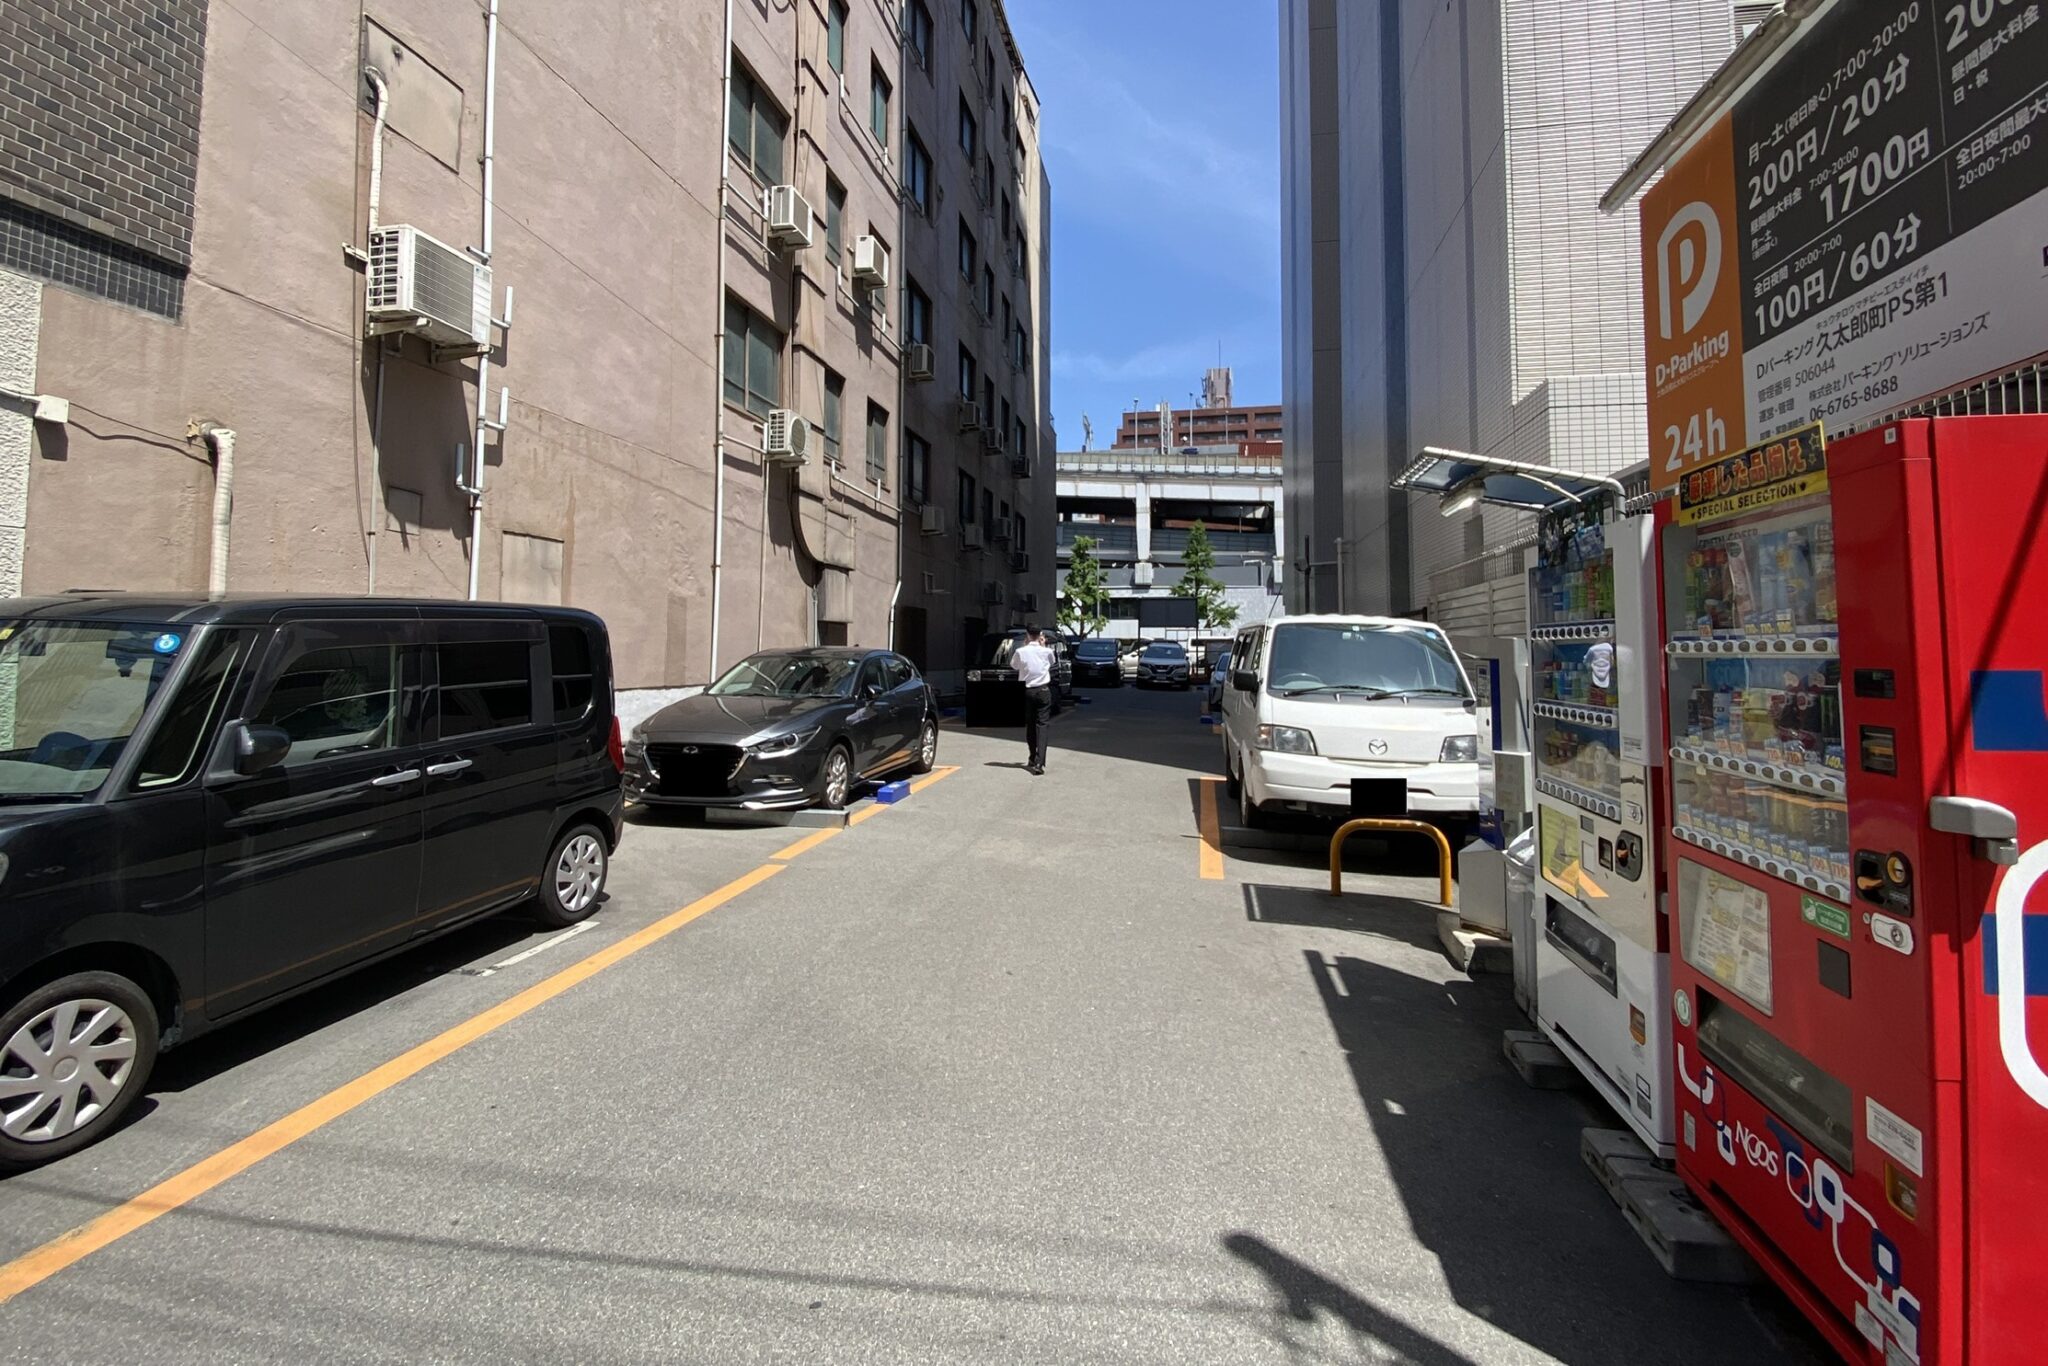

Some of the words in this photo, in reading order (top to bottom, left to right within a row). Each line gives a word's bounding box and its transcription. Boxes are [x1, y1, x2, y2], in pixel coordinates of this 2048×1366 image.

[1833, 2, 1918, 90] 7:00-20:00
[1956, 92, 2048, 170] 全日夜間最大
[1820, 127, 1930, 223] 1700円
[1958, 134, 2031, 190] 20:00-7:00
[1794, 233, 1843, 273] 20:00-7:00
[1809, 375, 1898, 422] 06-6765-8688
[1664, 407, 1726, 473] 24h
[1696, 500, 1734, 519] SPECIAL
[1738, 482, 1797, 509] SELECTION
